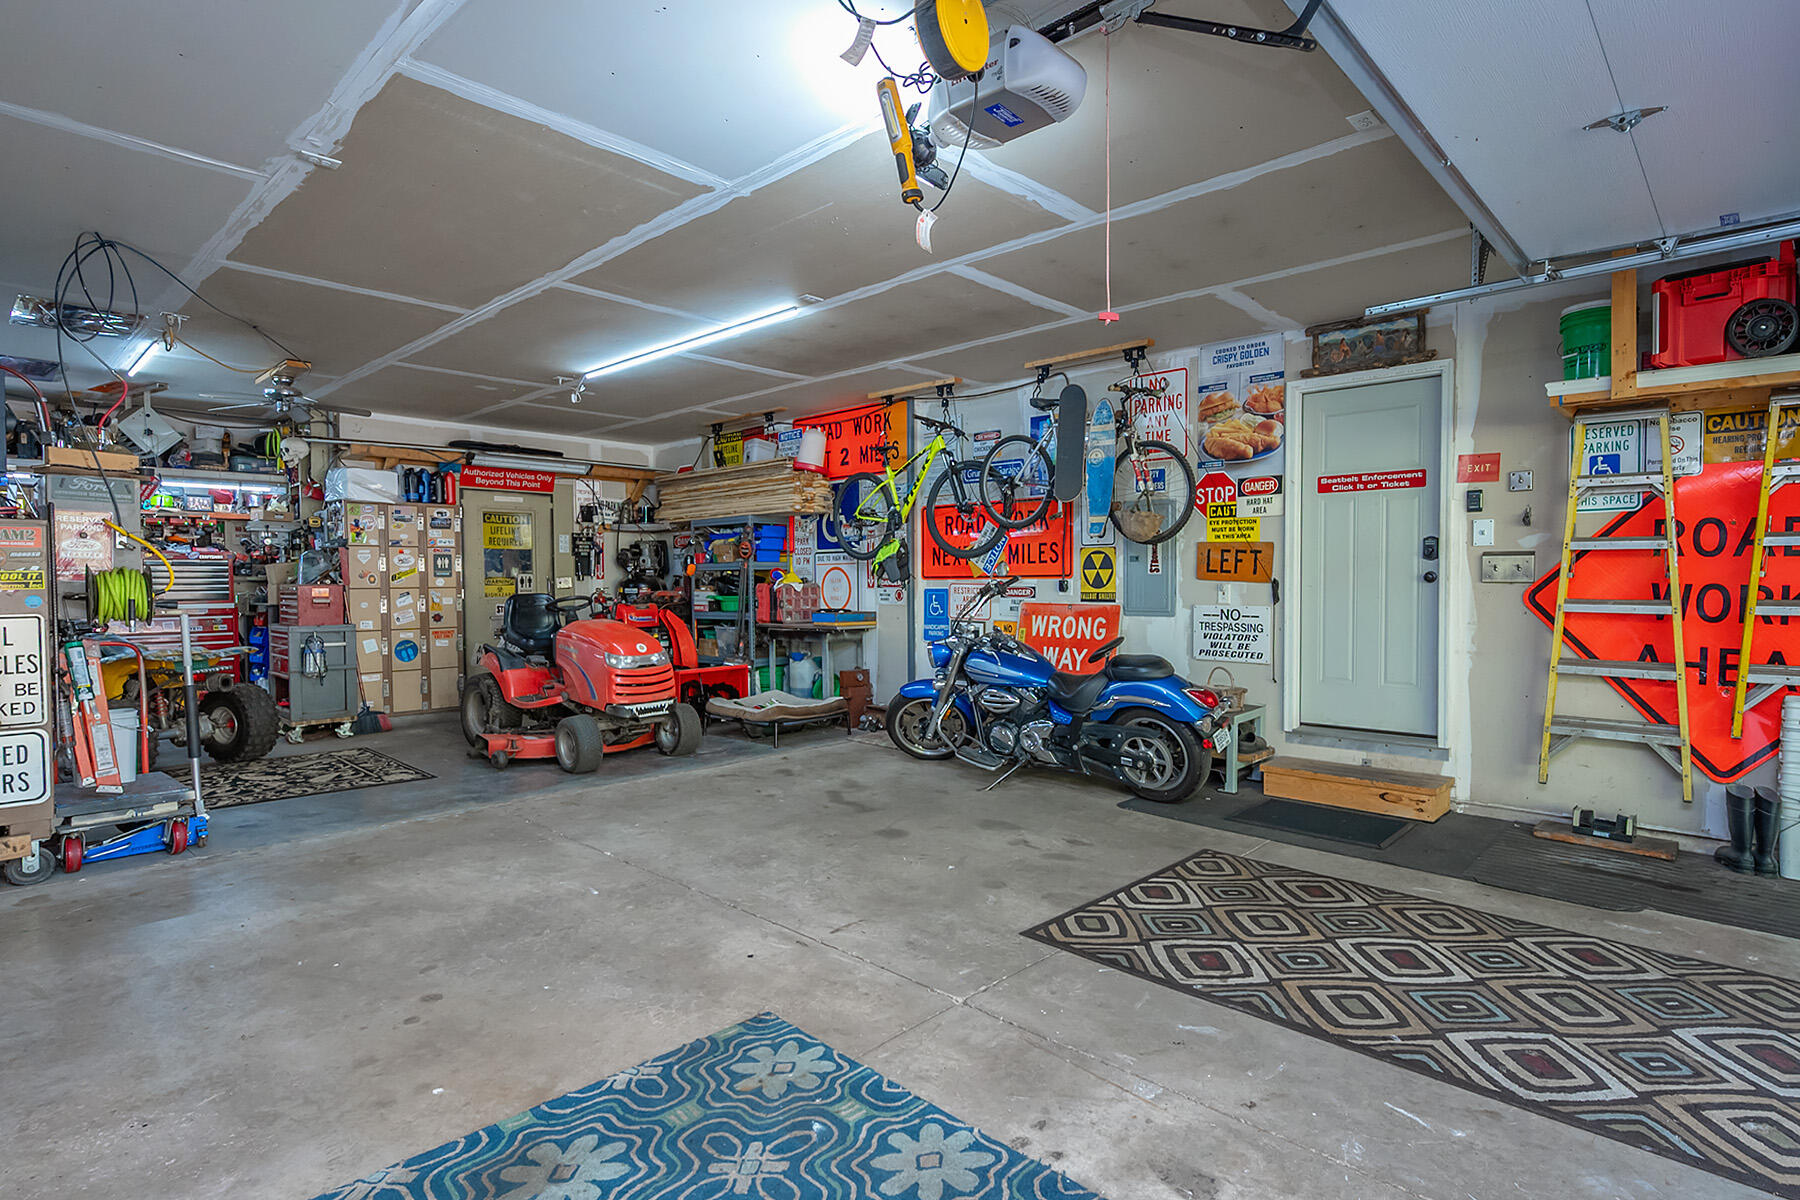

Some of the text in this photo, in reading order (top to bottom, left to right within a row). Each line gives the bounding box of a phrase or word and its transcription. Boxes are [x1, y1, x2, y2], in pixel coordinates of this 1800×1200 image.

[1215, 346, 1237, 355] COOKED
[1246, 341, 1266, 350] ORDER
[1212, 347, 1270, 365] CRISPY, GOLDEN
[1226, 360, 1255, 369] FAVORITES
[1149, 377, 1166, 393] NO
[1134, 393, 1183, 415] PARKING
[853, 411, 892, 436] WORK
[1146, 414, 1170, 429] ANY
[1649, 416, 1698, 427] No obacco
[718, 431, 742, 444] AUTION
[781, 430, 802, 441] NOTICE
[1145, 429, 1172, 442] TIME
[1584, 424, 1635, 440] ESERVED
[1712, 434, 1745, 445] HEARING
[1583, 439, 1630, 454] PARKING
[840, 447, 850, 467] 2
[1467, 463, 1491, 473] EXIT
[463, 468, 553, 483] Authorized Vehicles Only
[1320, 471, 1423, 485] Seatbelt Enforcement
[68, 476, 116, 491] Ford
[475, 477, 541, 488] Beyond This Point
[1244, 480, 1275, 493] DANGER
[1331, 484, 1354, 492] Click
[1380, 480, 1411, 488] Ticket
[1196, 486, 1235, 505] STOP
[1246, 496, 1274, 506] HARD HAT
[1577, 494, 1636, 507] HIS SPACE
[1210, 505, 1237, 517] CAUT
[1252, 506, 1267, 514] AREA
[56, 514, 105, 524] RESERVE
[484, 514, 528, 524] CAUTION
[944, 509, 1050, 536] ROAD ORK
[60, 523, 106, 532] PARKING
[490, 525, 519, 536] LIFELIN
[795, 547, 812, 556] CLOSED
[932, 542, 1060, 567] NEX MILES
[983, 535, 1009, 575] NOTICE
[802, 557, 810, 565] PM
[1206, 548, 1263, 576] LEFT
[1005, 587, 1033, 596] DANGER
[1098, 592, 1116, 600] SHELTER
[496, 605, 505, 614] ST
[1220, 608, 1242, 621] NO
[1003, 625, 1013, 633] NO
[1031, 614, 1107, 641] WRONG
[1199, 621, 1264, 634] TRESPASSING
[3, 626, 14, 647] L
[1203, 632, 1259, 643] VIOLATORS
[1209, 641, 1251, 651] WILL BE
[1043, 646, 1089, 672] WAY
[1198, 649, 1264, 660] PROSECUTED
[0, 653, 39, 676] LES
[15, 682, 39, 697] BE
[3, 744, 29, 766] ED
[3, 771, 30, 794] RS
